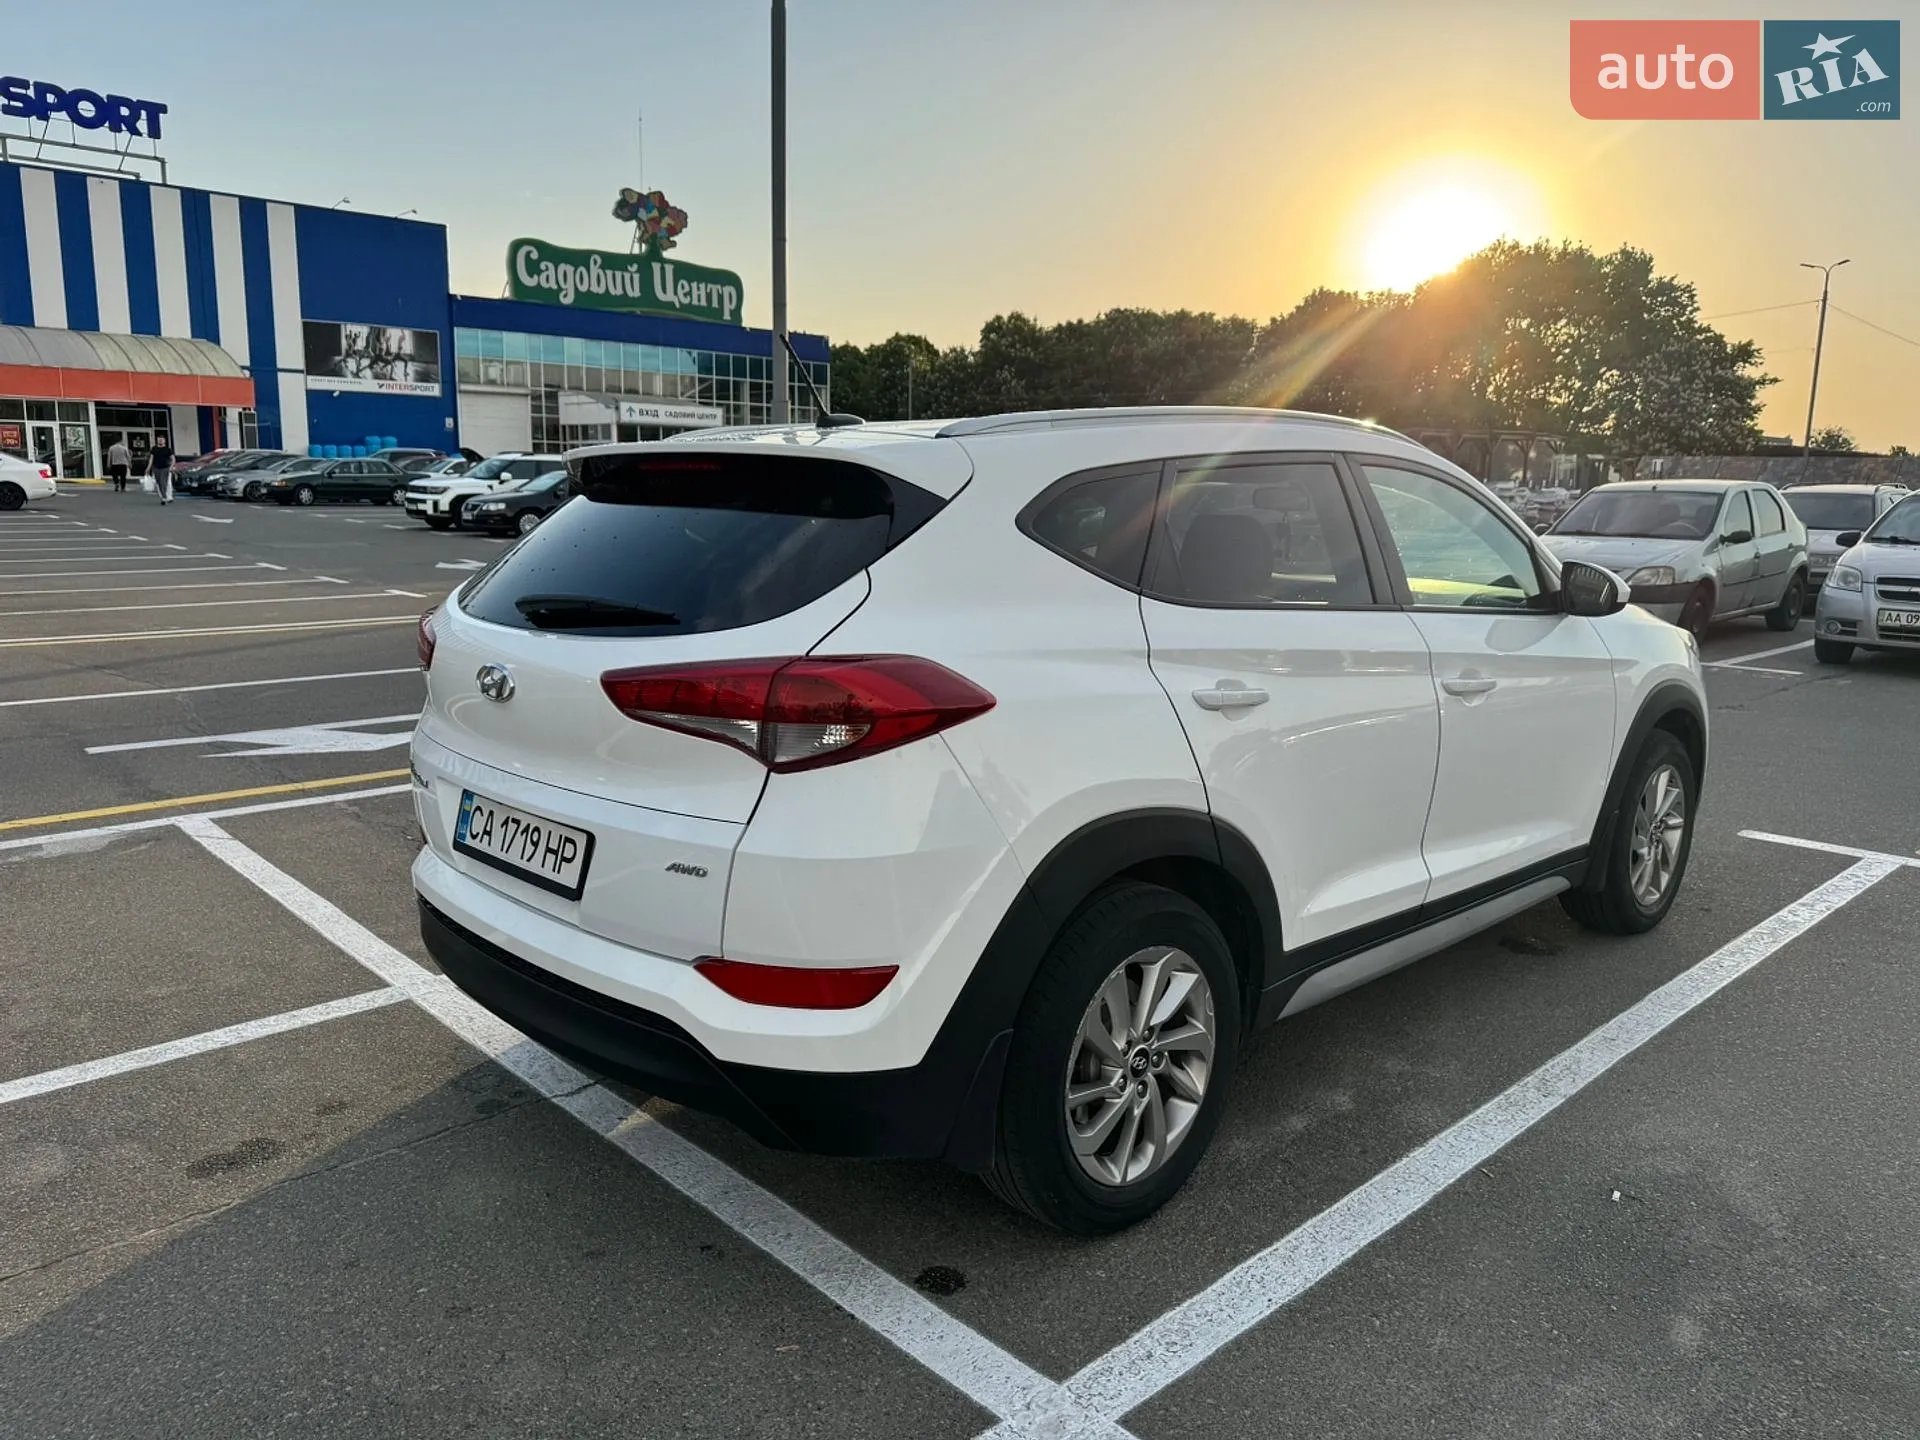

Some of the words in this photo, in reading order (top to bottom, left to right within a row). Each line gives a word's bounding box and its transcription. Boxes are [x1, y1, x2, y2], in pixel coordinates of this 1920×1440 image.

[0, 76, 168, 139] SPORT
[516, 245, 641, 304] Садовий
[651, 262, 737, 320] Центр
[385, 383, 436, 393] INTERSPORT
[638, 408, 659, 418] ВХІД
[1885, 612, 1902, 624] AA
[469, 805, 495, 847] CA
[500, 815, 541, 863] 1719
[541, 829, 578, 875] HP
[664, 861, 709, 878] AWD
